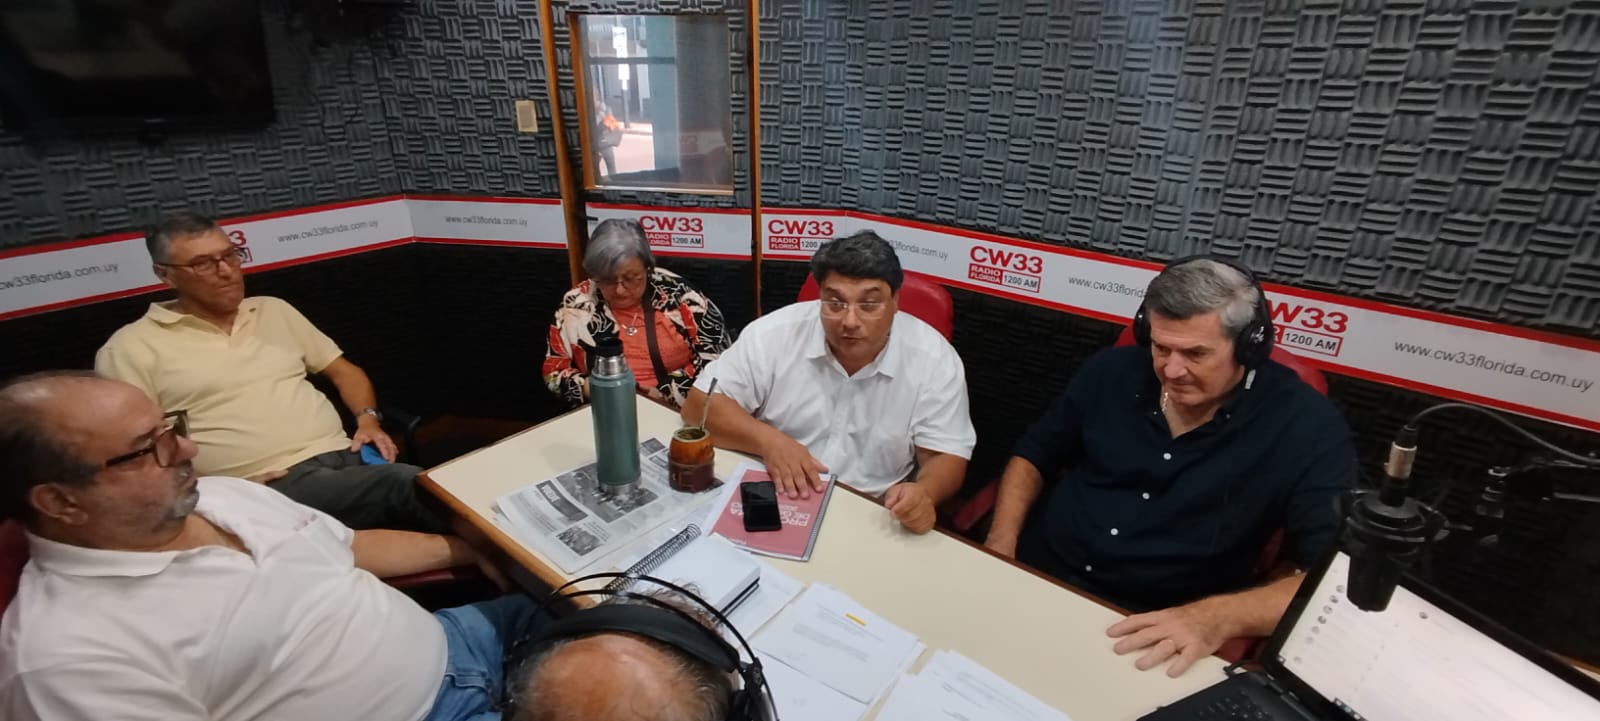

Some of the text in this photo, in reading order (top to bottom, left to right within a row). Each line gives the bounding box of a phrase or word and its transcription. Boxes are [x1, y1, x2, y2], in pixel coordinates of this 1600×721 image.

[277, 220, 379, 243] www.cw33florida.com.uy
[640, 215, 704, 233] CW33
[768, 219, 834, 236] CW33
[672, 237, 689, 245] 1200
[771, 236, 799, 244] RADIO
[801, 240, 818, 248] 1200
[970, 246, 1043, 274] CW33
[970, 271, 1001, 283] FLORIDA
[971, 264, 1000, 277] RADIO
[1004, 274, 1038, 288] 1200 AM
[1266, 299, 1348, 333] W33
[1285, 332, 1312, 346] 1200
[1314, 339, 1337, 352] AM
[1394, 341, 1594, 393] www.cw33florida.com.uy
